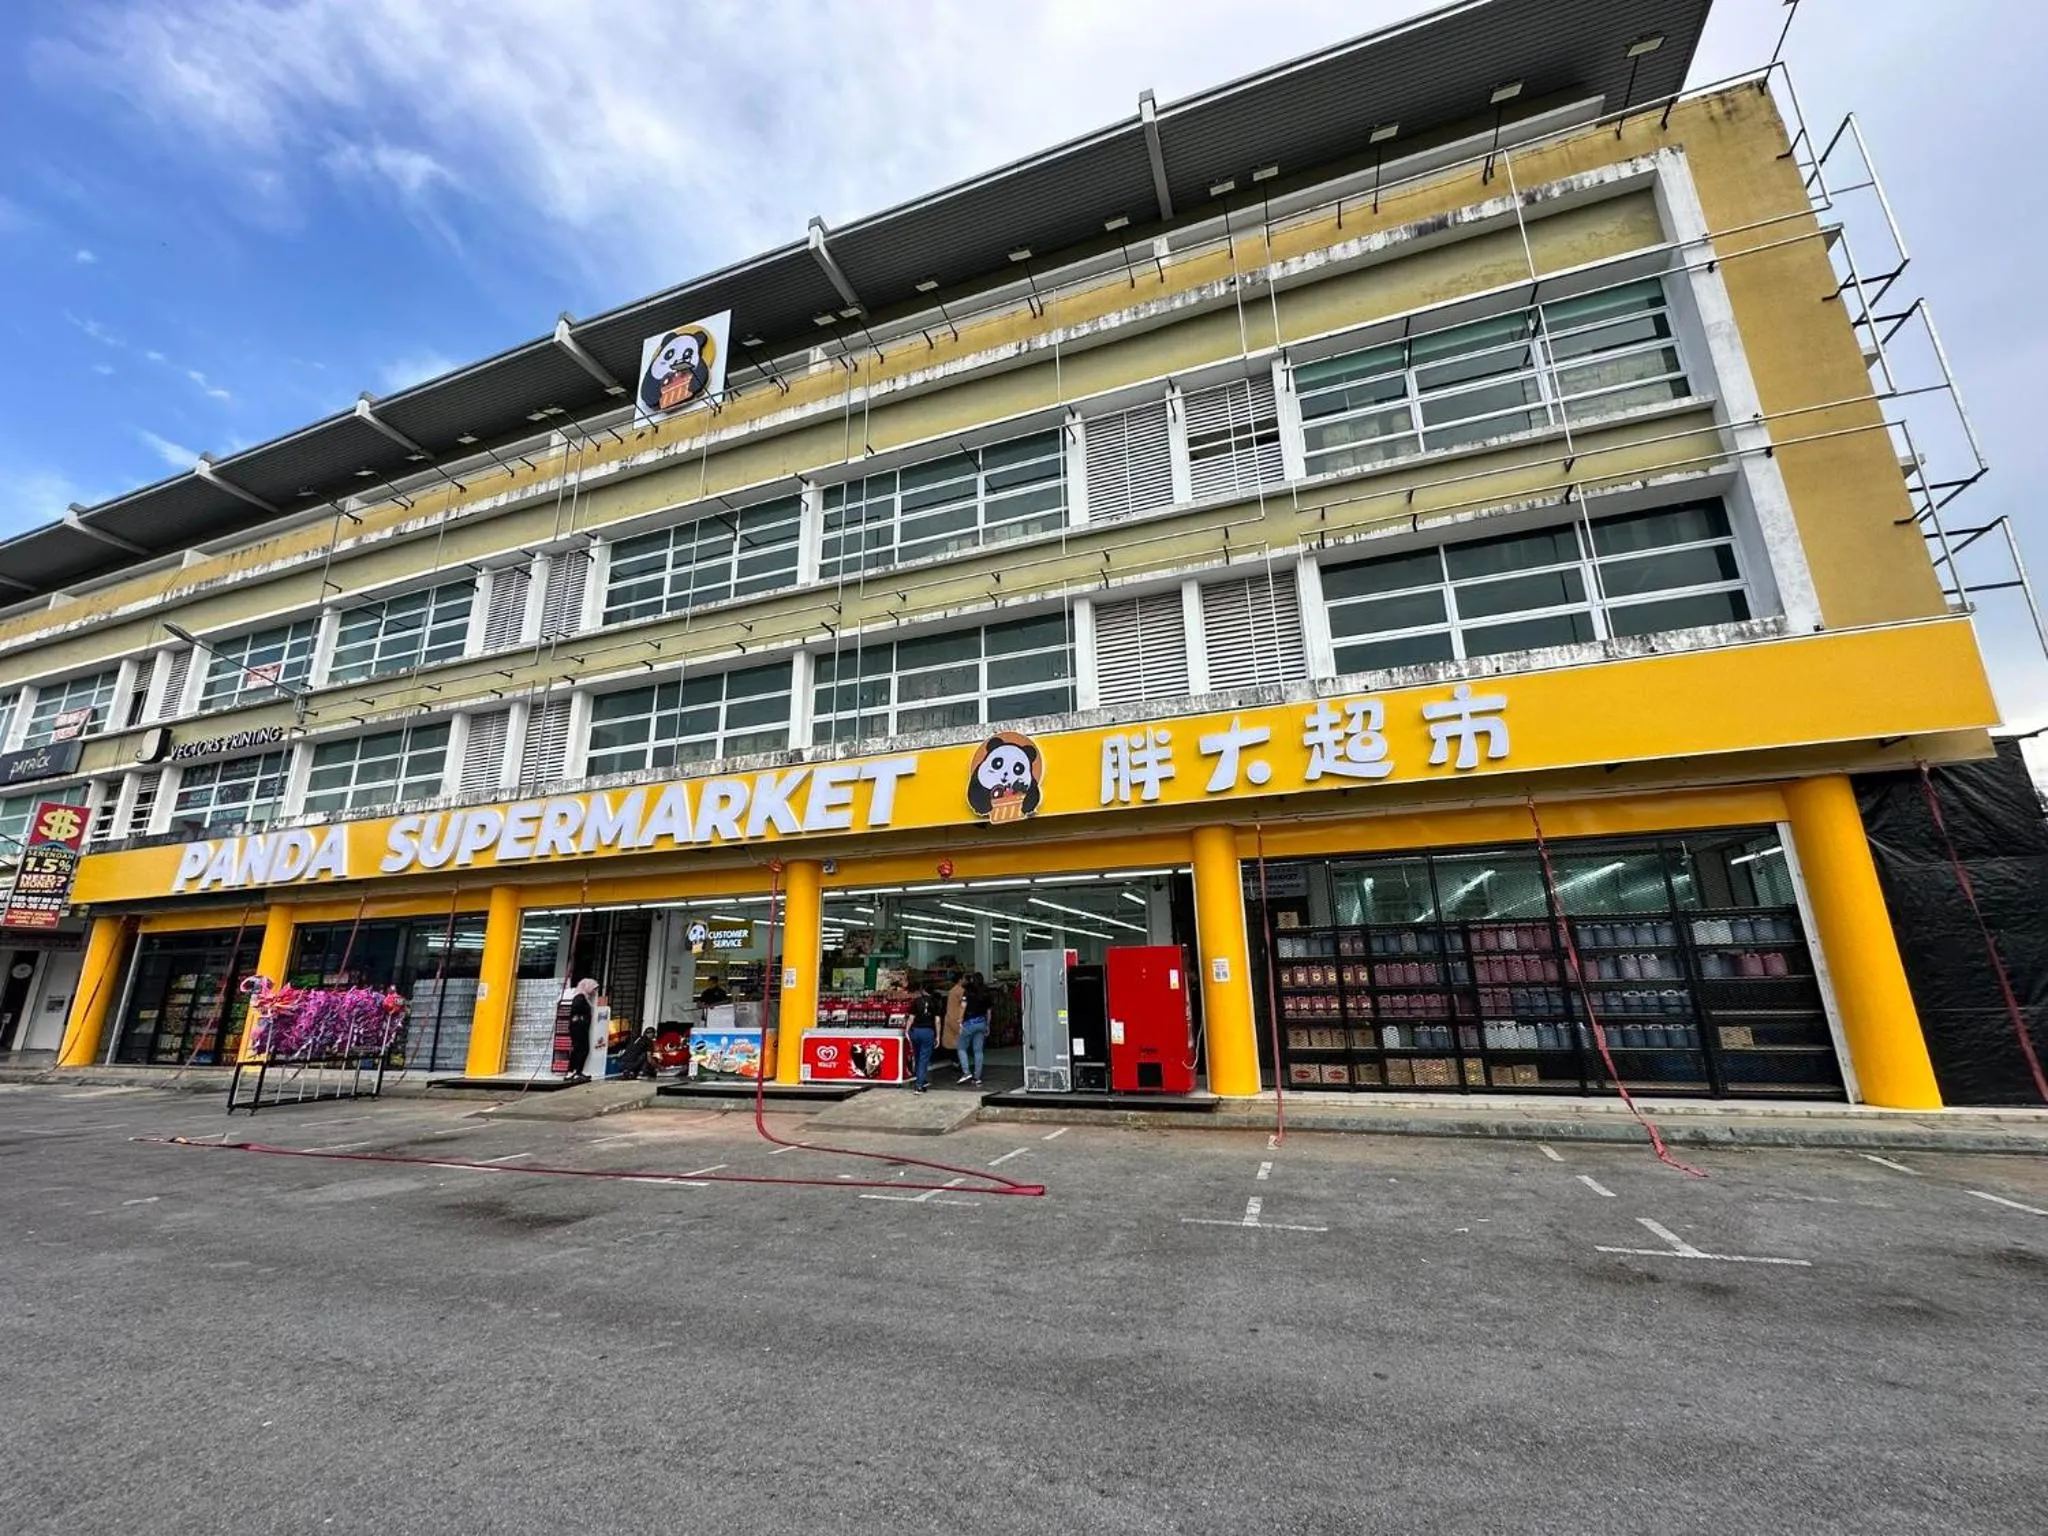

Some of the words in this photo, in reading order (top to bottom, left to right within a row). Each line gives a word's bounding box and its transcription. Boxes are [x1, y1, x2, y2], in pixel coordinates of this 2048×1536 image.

[172, 737, 225, 760] VECTORS
[227, 726, 283, 751] PRINTING
[171, 824, 349, 893] PANDA
[380, 756, 917, 873] SUPERMARKET
[708, 929, 749, 940] CUSTOMER
[712, 939, 743, 949] SERVICE
